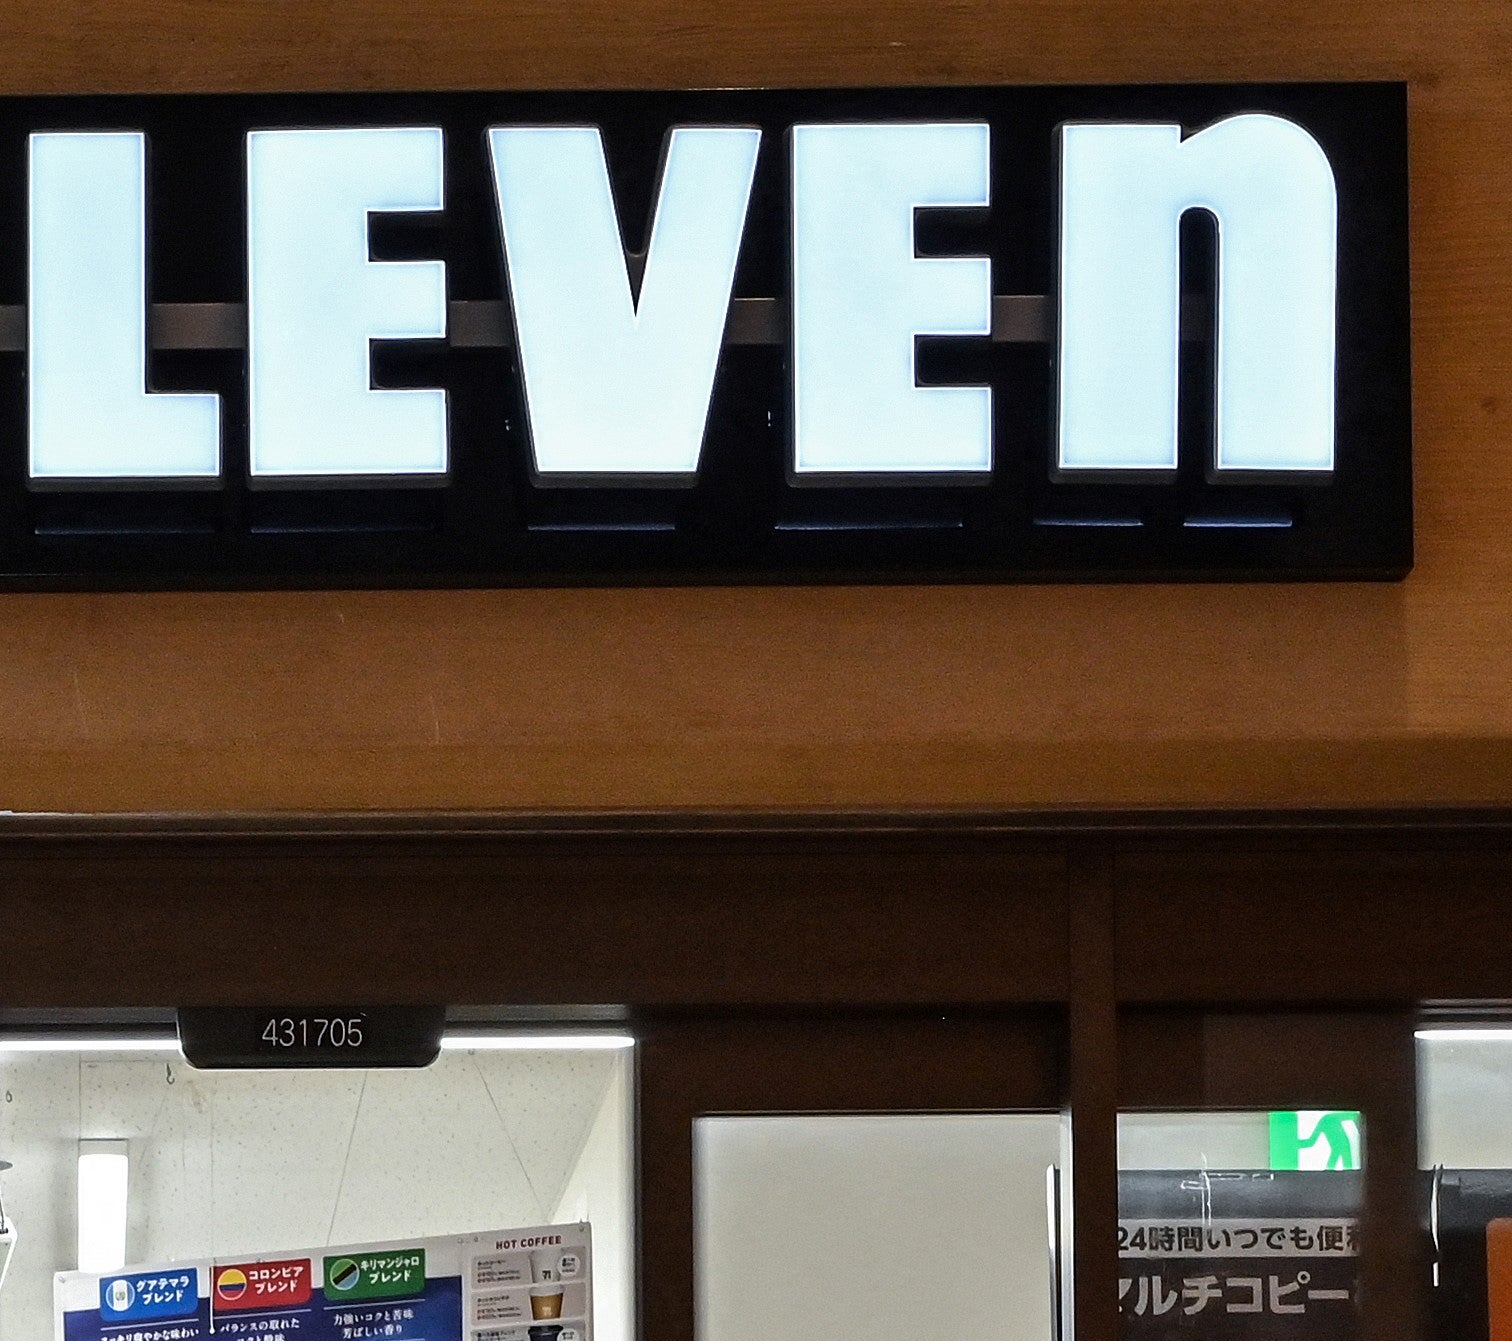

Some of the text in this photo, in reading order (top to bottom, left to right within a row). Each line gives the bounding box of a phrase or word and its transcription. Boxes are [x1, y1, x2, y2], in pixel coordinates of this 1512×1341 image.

[262, 1018, 363, 1046] 431705
[496, 1236, 562, 1250] HOT COFFEE
[360, 1256, 420, 1272] キリマンジャロ
[248, 1266, 304, 1281] コロンビア
[369, 1269, 411, 1284] ブレンド
[136, 1275, 190, 1292] グアテマラ
[255, 1279, 298, 1295] ブレンド
[142, 1289, 185, 1305] ブレンド
